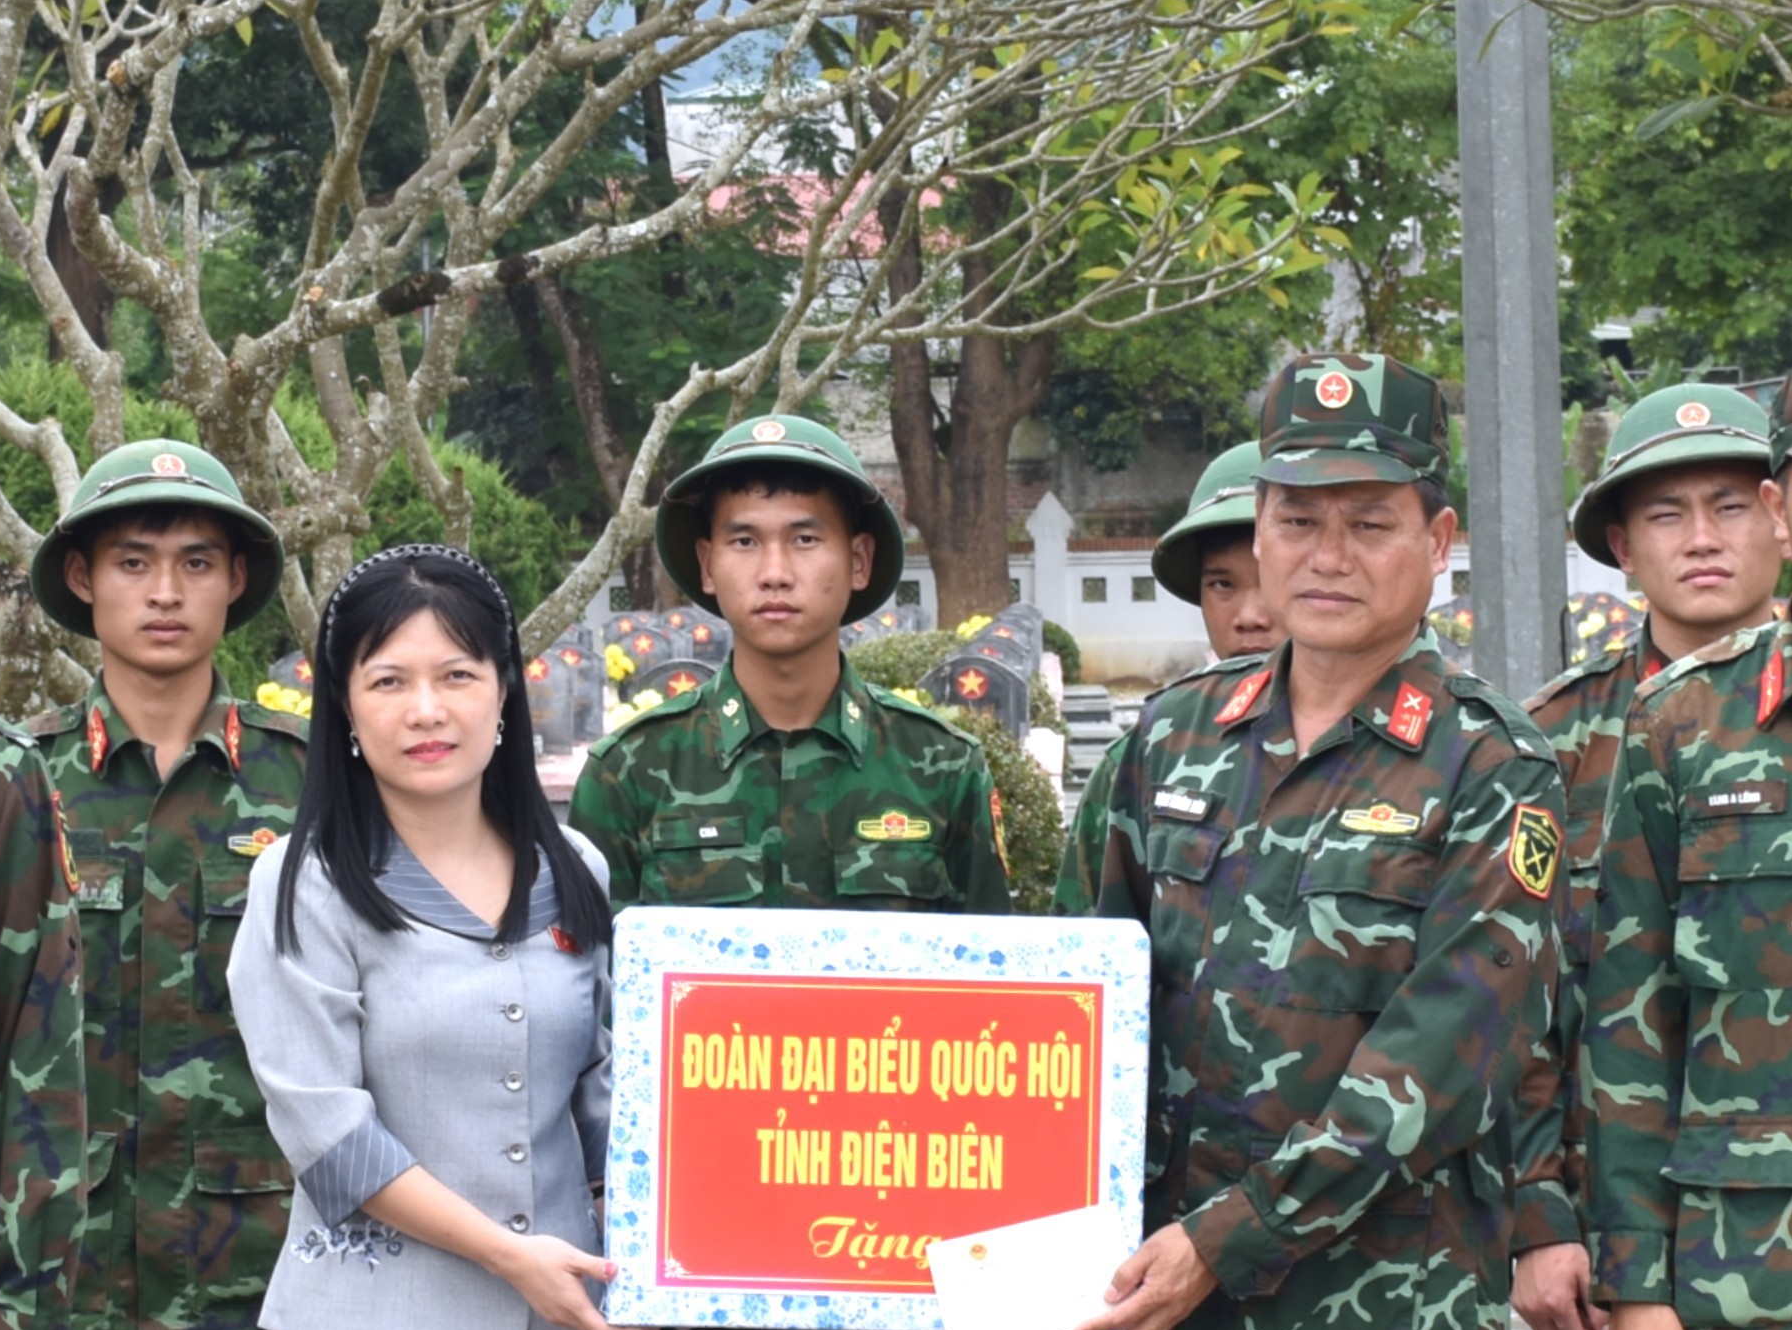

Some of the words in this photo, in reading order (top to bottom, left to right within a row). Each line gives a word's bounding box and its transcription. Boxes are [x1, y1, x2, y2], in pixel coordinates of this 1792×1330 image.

[682, 1023, 772, 1091] ĐOÀN
[781, 1036, 836, 1104] ĐẠI
[846, 1016, 920, 1095] BIỂU
[929, 1021, 1017, 1101] QUỐC
[1027, 1031, 1081, 1111] HỘI
[757, 1108, 831, 1185] TỈNH
[840, 1120, 917, 1200] ĐIỆN
[927, 1122, 1003, 1190] BIÊN
[809, 1215, 941, 1270] Tặng
